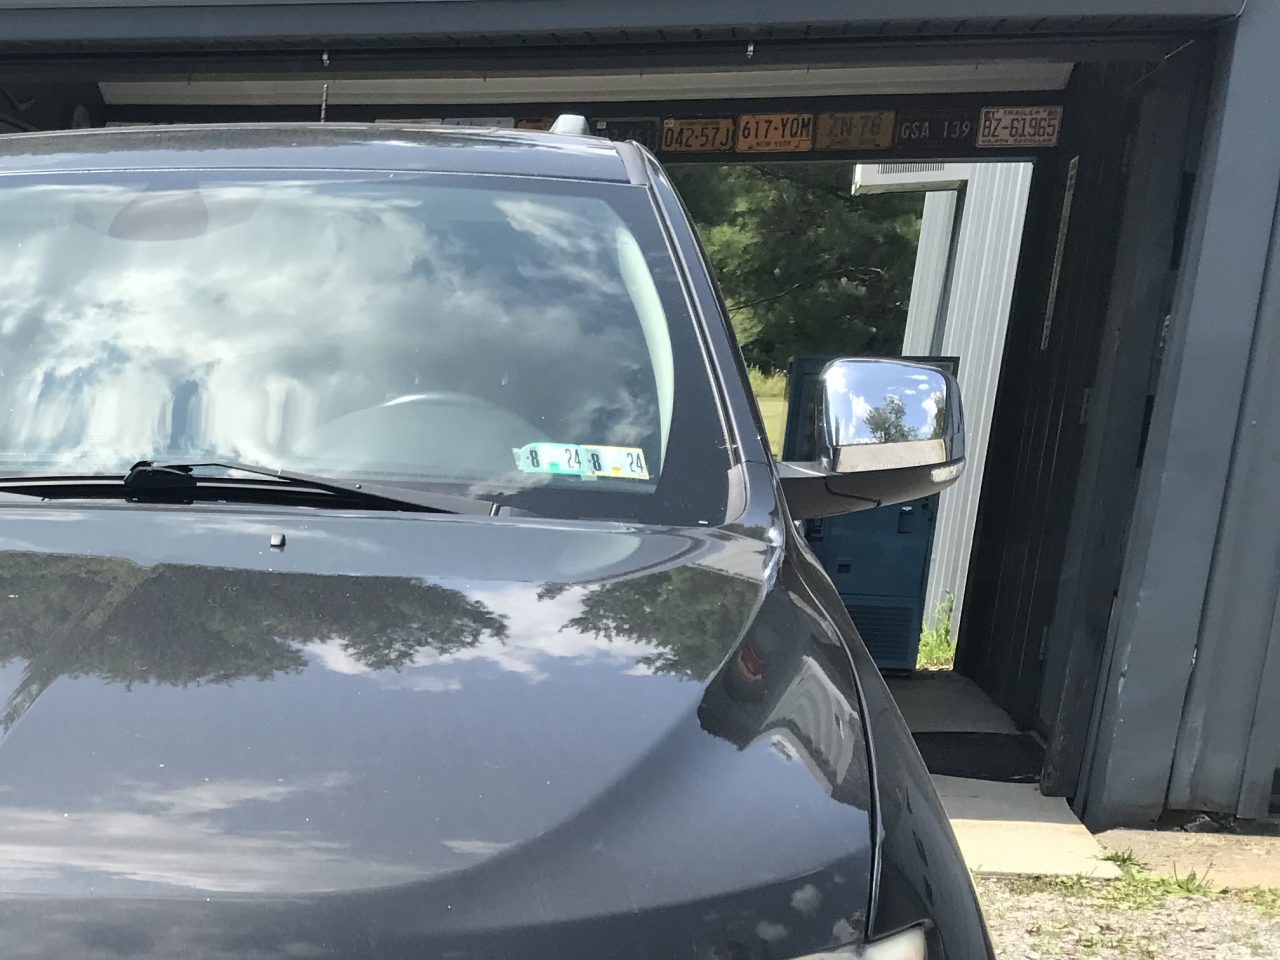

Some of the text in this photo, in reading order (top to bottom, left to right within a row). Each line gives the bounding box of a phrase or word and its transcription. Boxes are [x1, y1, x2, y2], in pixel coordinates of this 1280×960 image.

[901, 121, 970, 138] GSA 139
[529, 450, 540, 468] 8
[590, 453, 602, 471] 8
